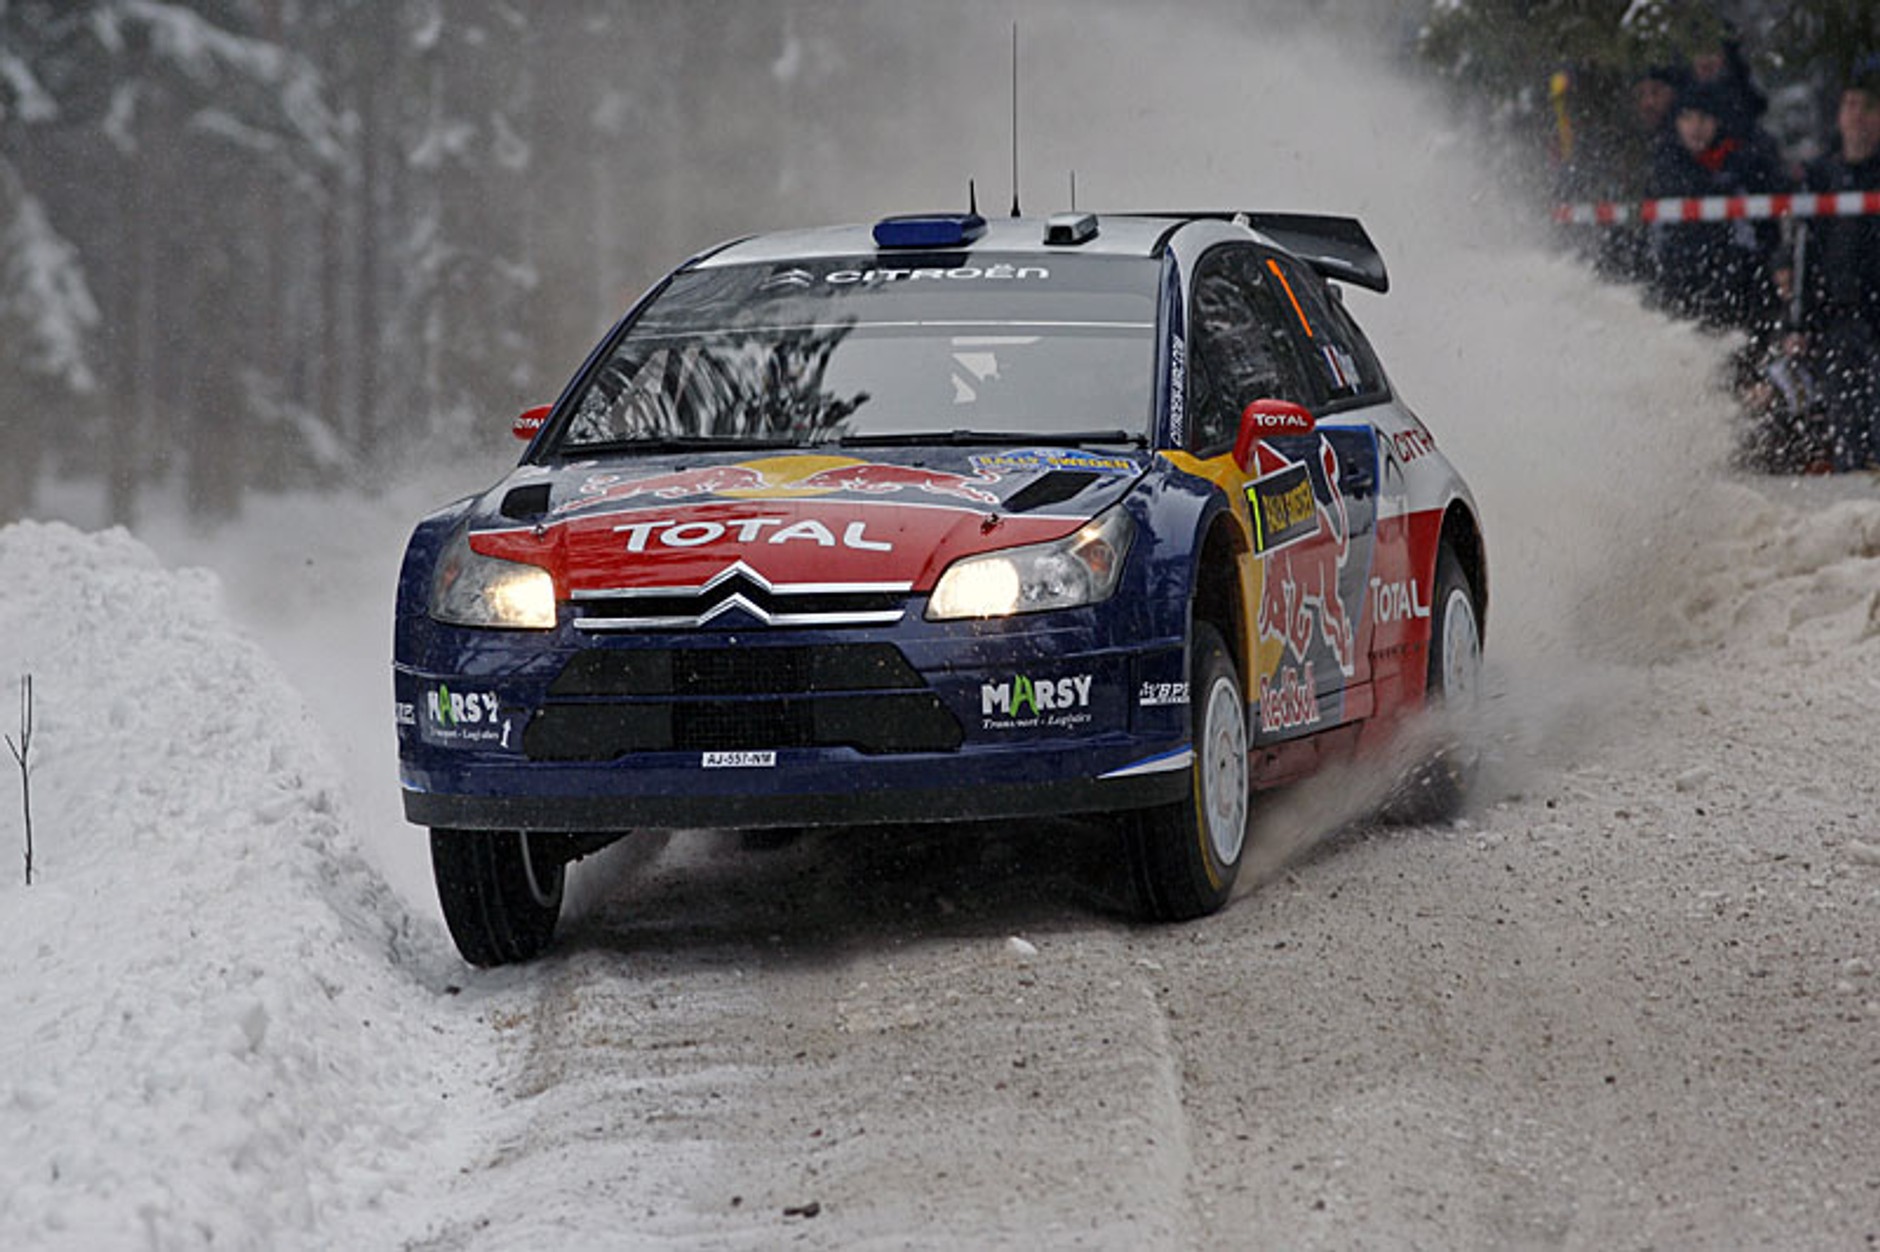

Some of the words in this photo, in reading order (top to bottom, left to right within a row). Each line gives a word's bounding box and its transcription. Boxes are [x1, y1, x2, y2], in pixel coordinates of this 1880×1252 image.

[514, 418, 544, 429] OTA
[1253, 413, 1308, 427] TOTAL
[612, 518, 892, 553] TOTAL
[1370, 577, 1430, 624] TOTAL
[427, 684, 498, 726] MARSY
[981, 674, 1092, 717] MARSY
